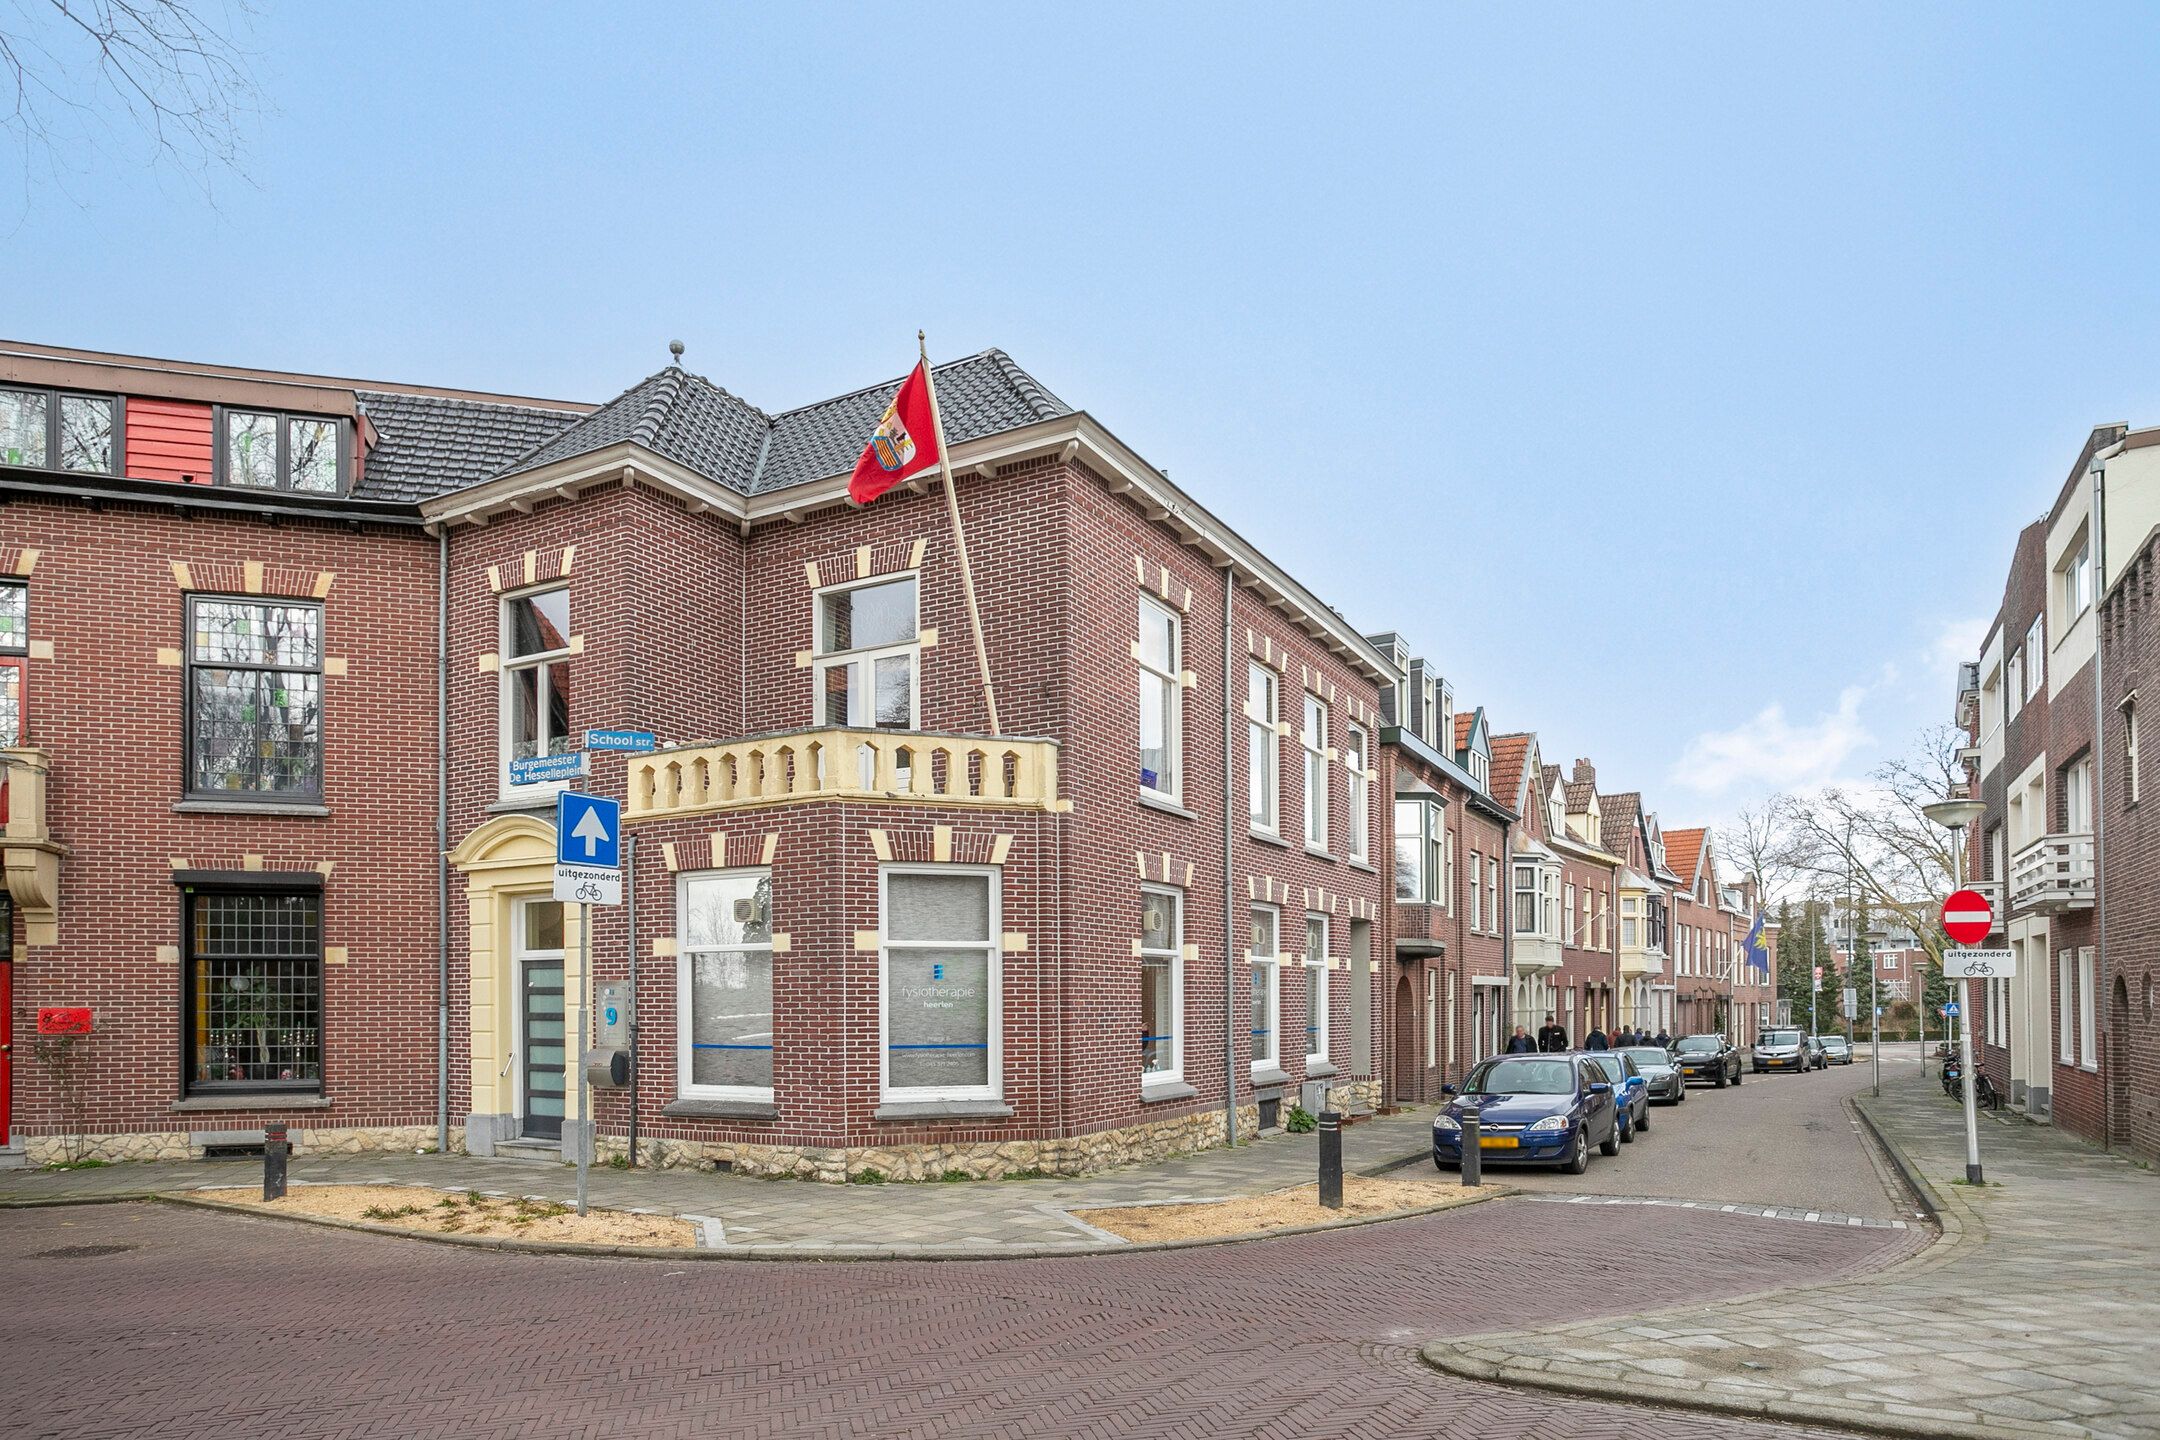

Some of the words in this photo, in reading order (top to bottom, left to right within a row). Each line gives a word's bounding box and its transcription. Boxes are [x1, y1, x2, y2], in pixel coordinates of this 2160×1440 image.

[590, 734, 633, 746] School
[635, 738, 654, 747] str.
[513, 755, 577, 771] Burgemeester
[509, 772, 521, 783] De
[524, 765, 583, 780] Hesselleplein
[558, 868, 621, 882] uitgezonderd
[1947, 950, 2012, 960] uitgezonderd
[902, 986, 976, 999] fysiotherapie
[605, 1007, 618, 1026] 9
